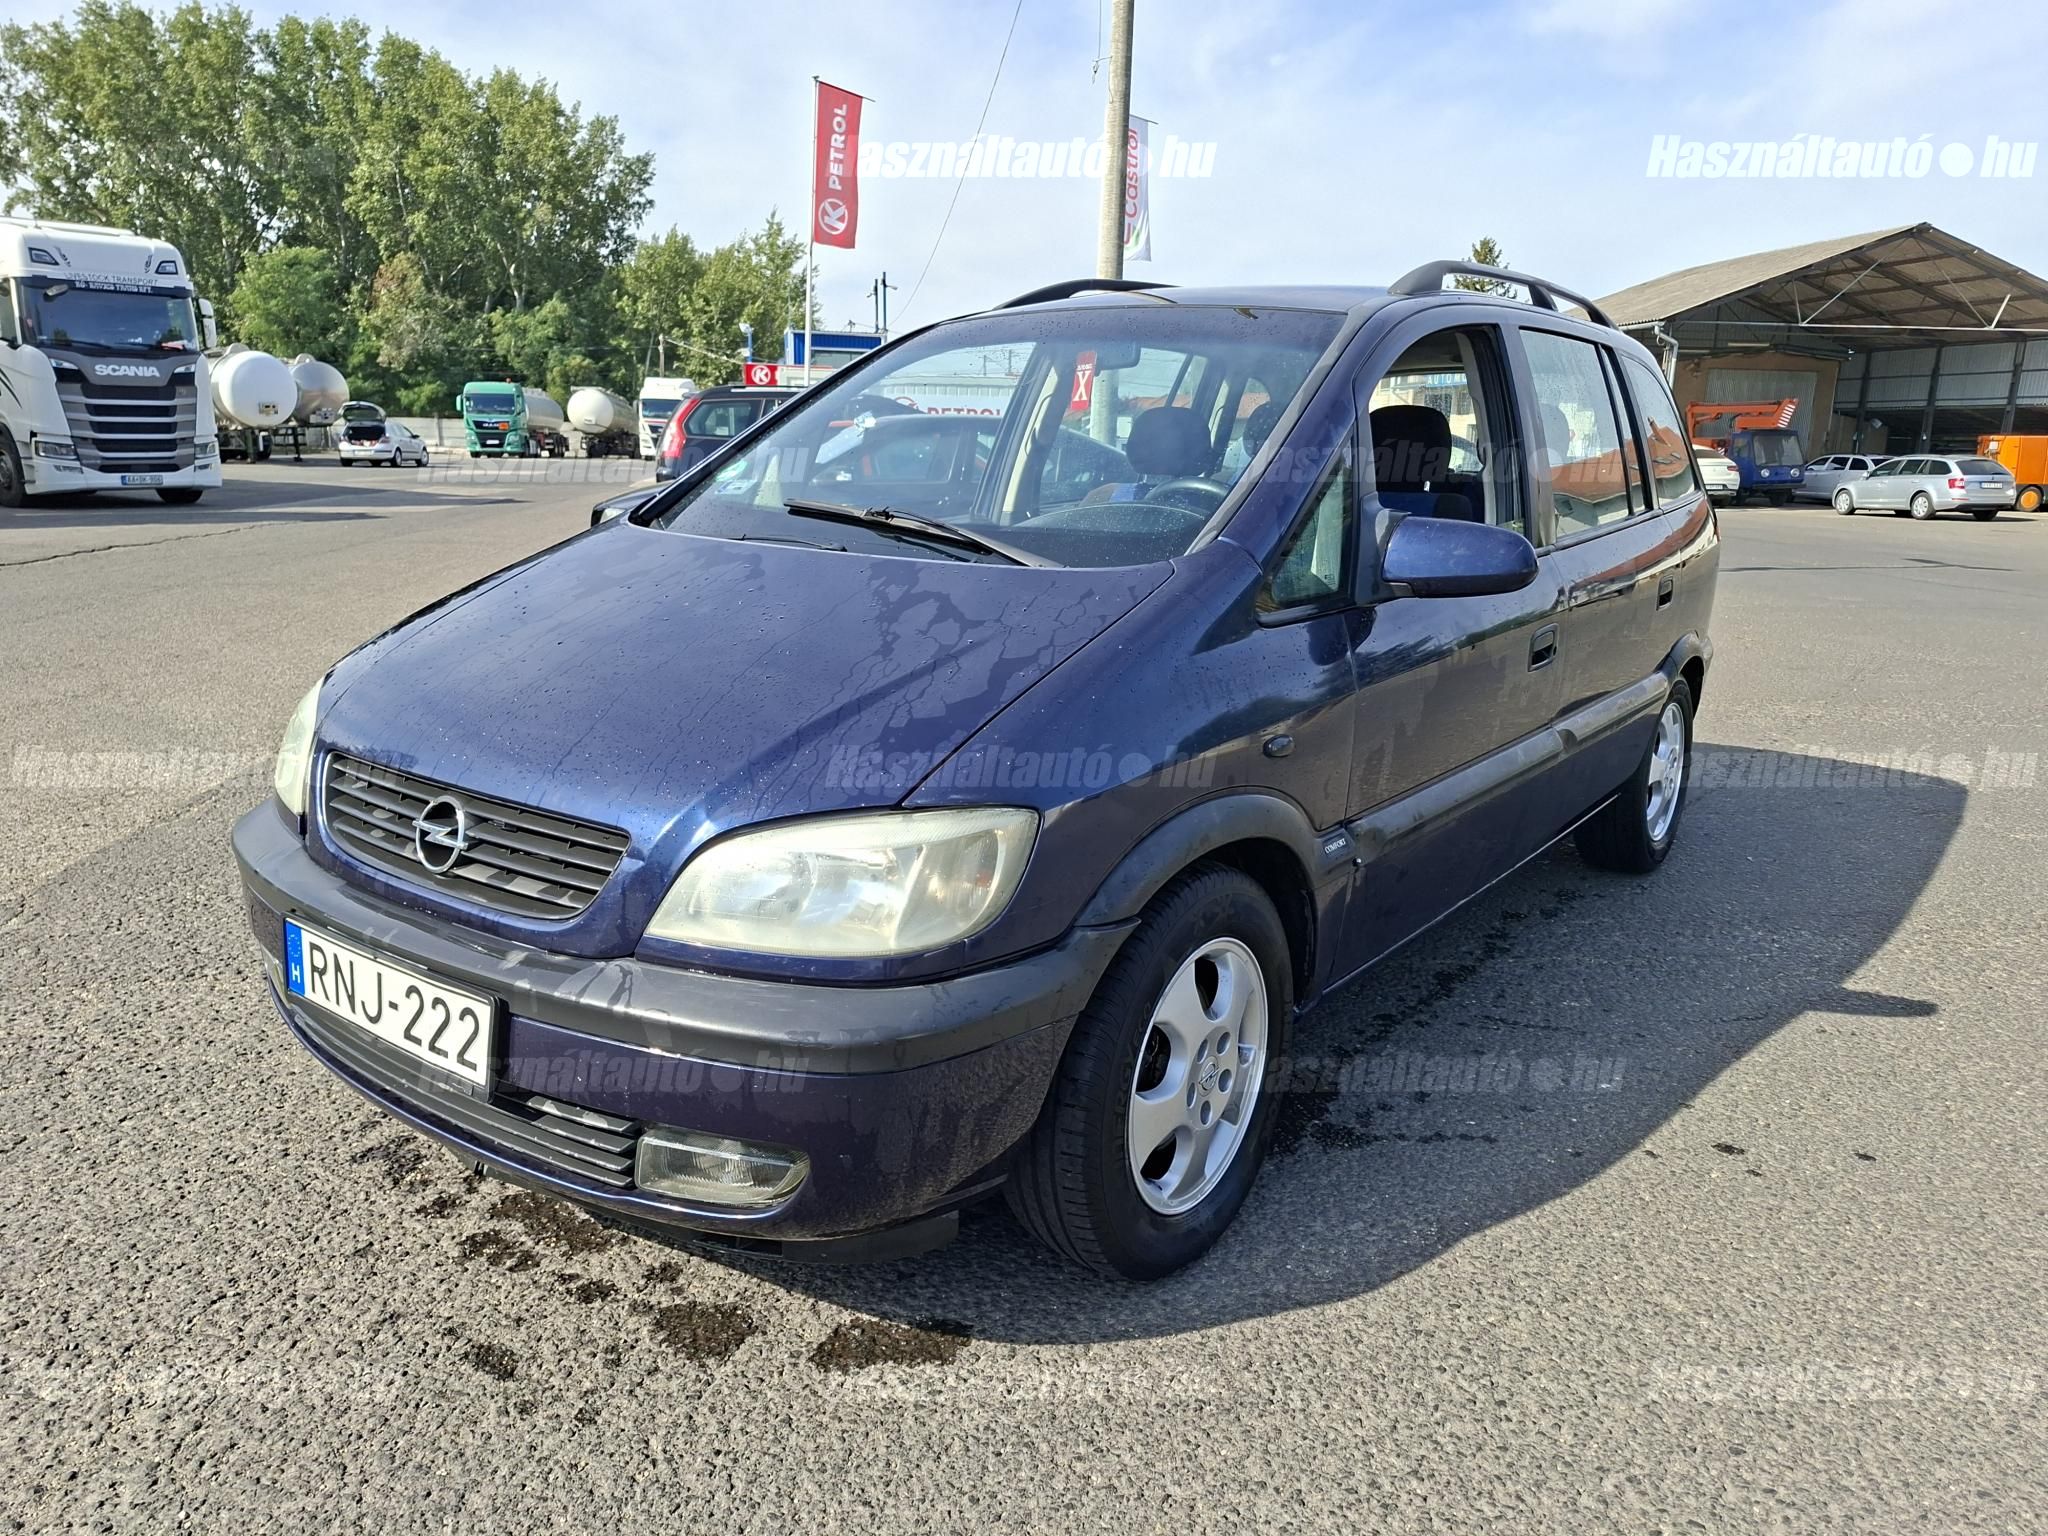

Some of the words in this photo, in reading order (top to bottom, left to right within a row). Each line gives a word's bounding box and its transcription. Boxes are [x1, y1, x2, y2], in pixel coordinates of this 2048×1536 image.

[829, 104, 848, 190] PETROL
[1125, 128, 1139, 219] Castrol
[110, 275, 158, 286] TRANSPORT
[94, 364, 161, 378] SCANIA
[291, 964, 301, 984] H
[308, 941, 480, 1072] RNJ-222
